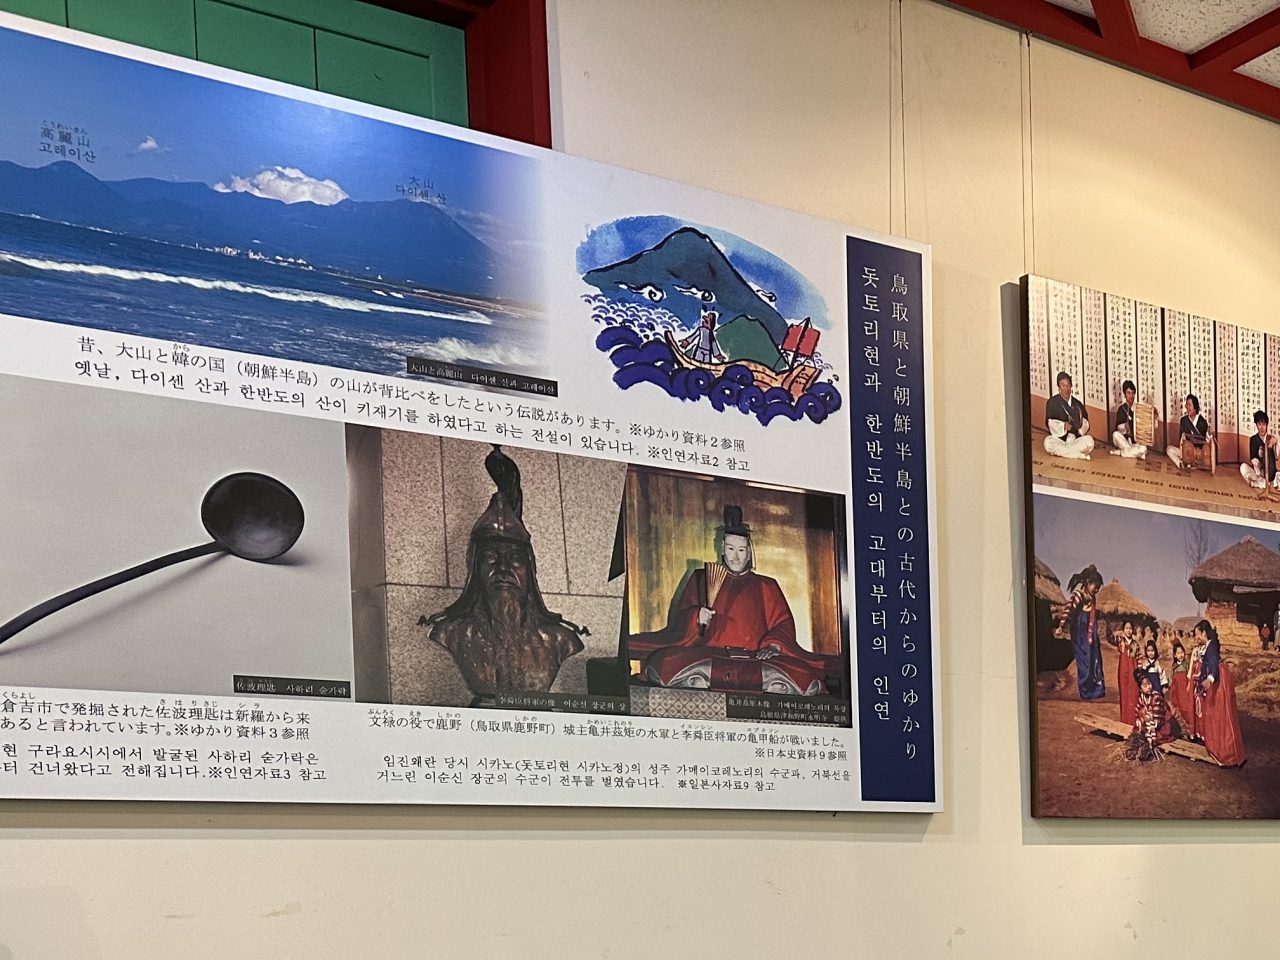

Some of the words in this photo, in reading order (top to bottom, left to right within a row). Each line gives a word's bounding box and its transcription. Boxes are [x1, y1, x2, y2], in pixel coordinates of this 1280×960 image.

[39, 141, 97, 163] 고레이산
[409, 175, 434, 190] 大山
[861, 266, 882, 393] 돗토리현과
[471, 373, 496, 385] 다이센
[501, 378, 517, 388] 산과
[522, 382, 555, 394] 고레이산
[75, 360, 120, 381] 옛날,
[131, 368, 185, 389] 다이센
[195, 378, 229, 396] 산과
[239, 384, 305, 409] 한반도의
[316, 396, 346, 413] 산이
[357, 402, 419, 423] 키재기를
[427, 413, 487, 432] 하였다고
[495, 423, 523, 439] 하는
[531, 428, 572, 446] 전설이
[581, 436, 639, 456] 있습니다.
[726, 457, 750, 471] 참고
[865, 413, 884, 513] 한반도의
[891, 273, 919, 759] 鳥取県と朝鮮半島との古代からのゆかり
[868, 534, 888, 656] 고대부터의
[2, 691, 35, 699] くらよし
[286, 684, 313, 694] 사하리
[873, 676, 890, 720] 인연
[564, 699, 586, 708] 이순신
[2, 743, 17, 757] 현
[28, 744, 142, 760] 구라요시시에서
[153, 748, 199, 762] 발굴된
[208, 750, 251, 763] 사하리
[260, 751, 319, 765] 숟가락은
[0, 761, 17, 775] 터
[29, 761, 112, 776] 건너왔다고
[299, 767, 326, 781] 참고
[383, 755, 436, 768] 임진왜란
[444, 756, 468, 769] 당시
[648, 763, 670, 775] 성주
[676, 764, 764, 777] 가메이코레노리의
[811, 769, 851, 781] 거북선을
[377, 770, 416, 783] 거느린
[425, 771, 463, 784] 이순신
[471, 772, 508, 785] 장군의
[515, 774, 551, 786] 수군이
[559, 775, 595, 787] 전투를
[755, 781, 776, 792] 참고
